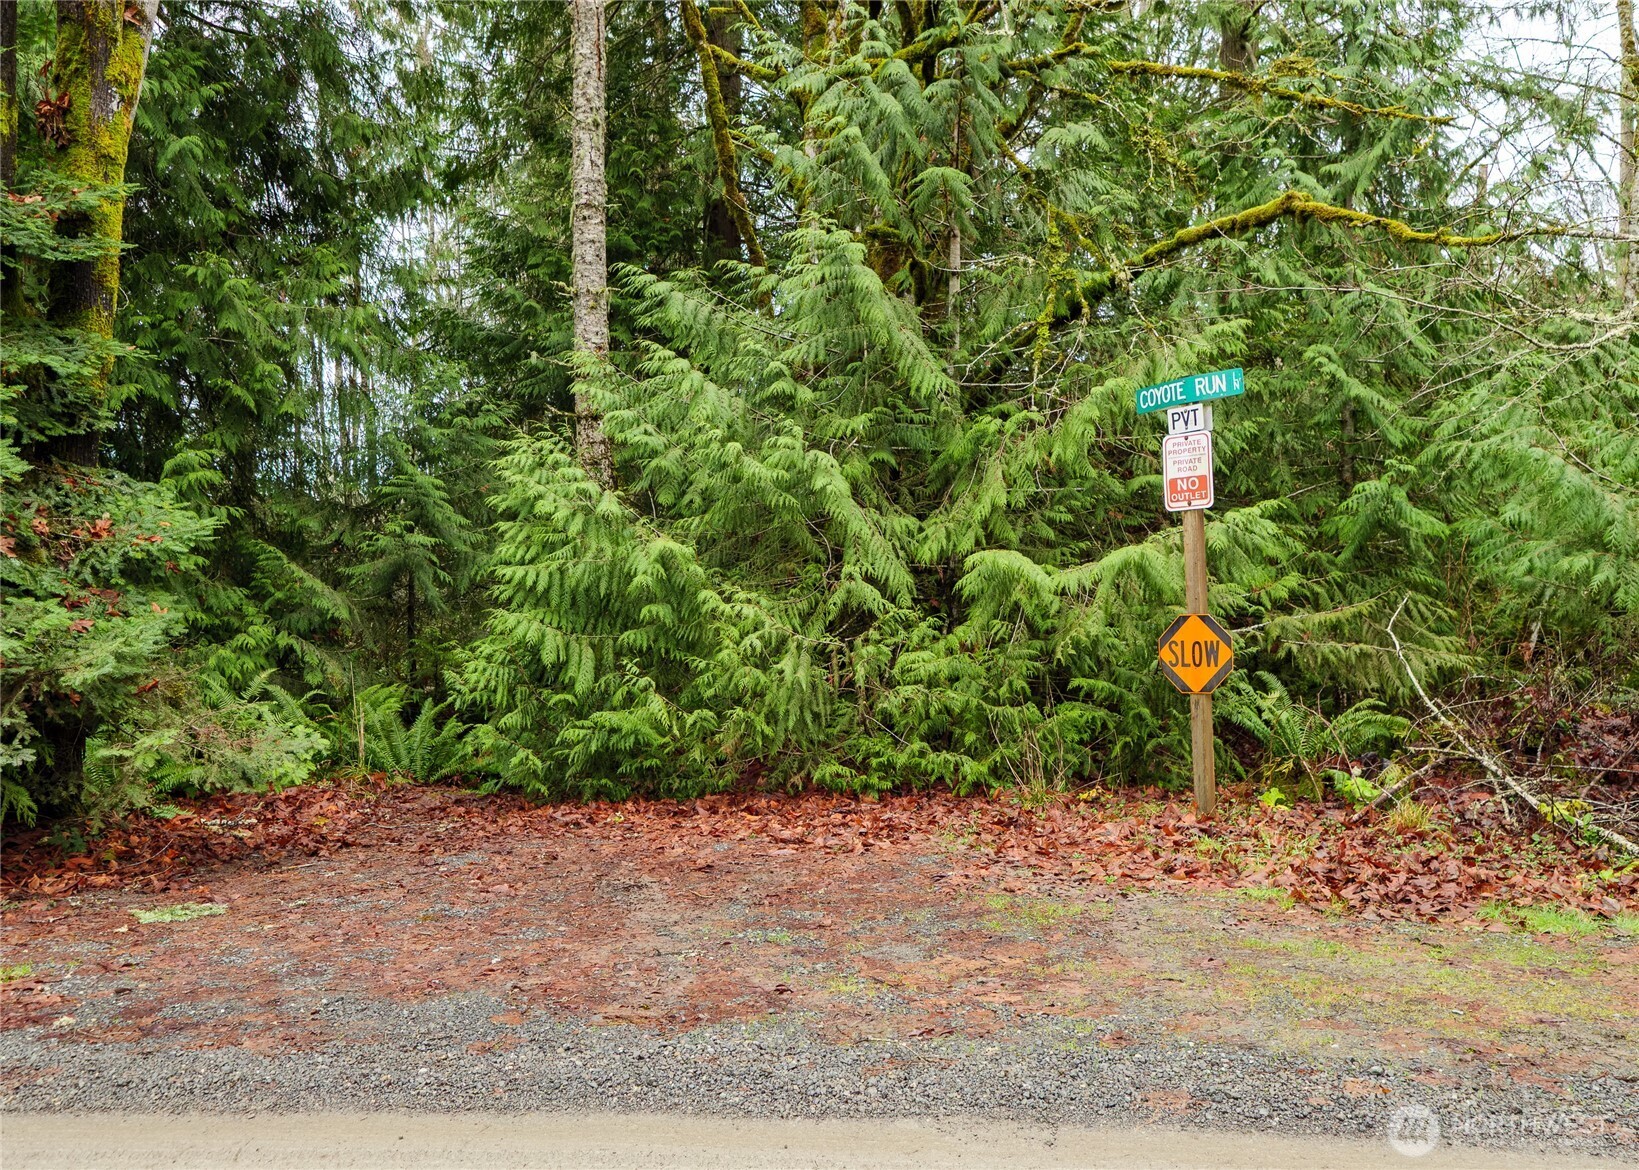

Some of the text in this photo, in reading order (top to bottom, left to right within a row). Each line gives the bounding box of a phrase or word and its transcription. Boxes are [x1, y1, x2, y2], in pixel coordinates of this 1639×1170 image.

[1140, 381, 1186, 408] COYOTE
[1195, 373, 1227, 397] RUN
[1171, 408, 1199, 430] PVT
[1172, 439, 1202, 448] PRIVATE
[1168, 445, 1207, 456] PROPERTY
[1172, 457, 1202, 466] PRIVATE
[1177, 465, 1198, 473] ROAD
[1176, 477, 1199, 491] NO
[1171, 490, 1207, 501] OUTLET
[1168, 640, 1220, 668] SLOW
